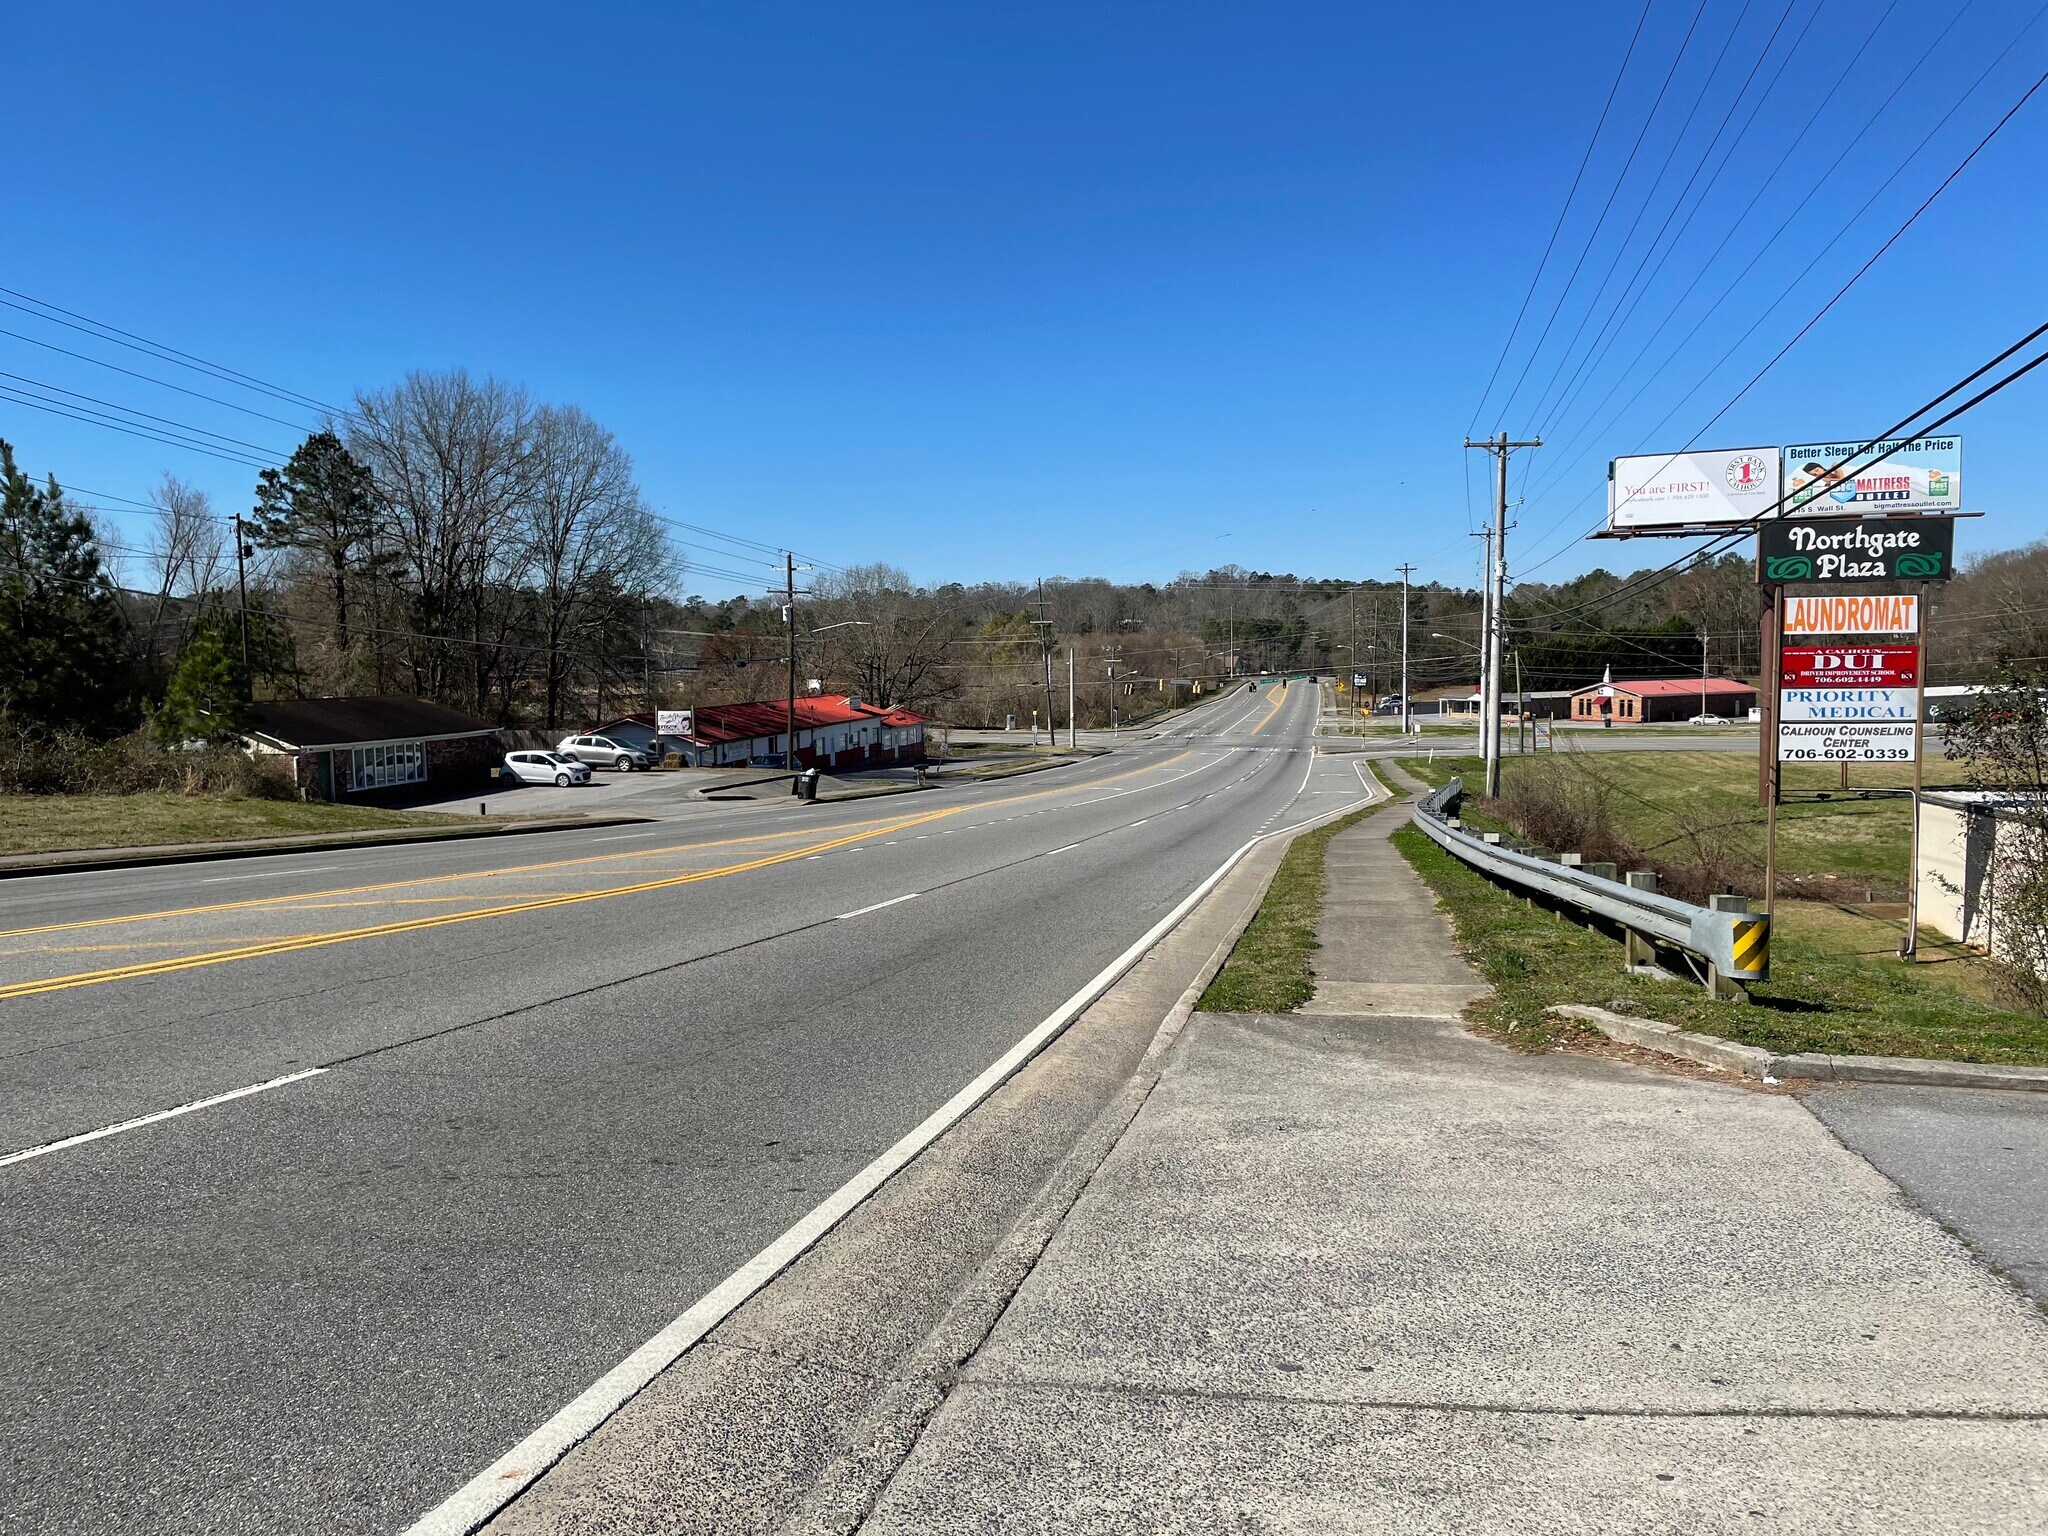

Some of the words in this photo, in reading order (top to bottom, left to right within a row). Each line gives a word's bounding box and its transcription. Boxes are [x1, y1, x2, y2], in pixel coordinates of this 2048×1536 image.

[1790, 447, 1822, 459] Better
[1825, 445, 1854, 457] Sleep
[1925, 438, 1954, 451] Price
[1624, 485, 1646, 496] You
[1649, 486, 1666, 494] are
[1669, 481, 1710, 493] FIRST!
[1857, 476, 1910, 492] MATTRESS
[1856, 491, 1909, 501] OUTLET
[1873, 500, 1952, 510] bigmattressoutlet.com
[1788, 525, 1921, 557] Northgate
[1816, 554, 1886, 579] Plaza
[1784, 596, 1915, 632] LAUNDROMAT
[1813, 654, 1885, 669] DUI
[1786, 690, 1896, 703] PRIORITY
[1808, 706, 1912, 719] MEDICAL
[1780, 726, 1837, 737] CALHOUN
[1839, 725, 1913, 737] COUNSELING
[1823, 737, 1870, 749] CENTER
[1784, 748, 1909, 760] 706-602-0339
